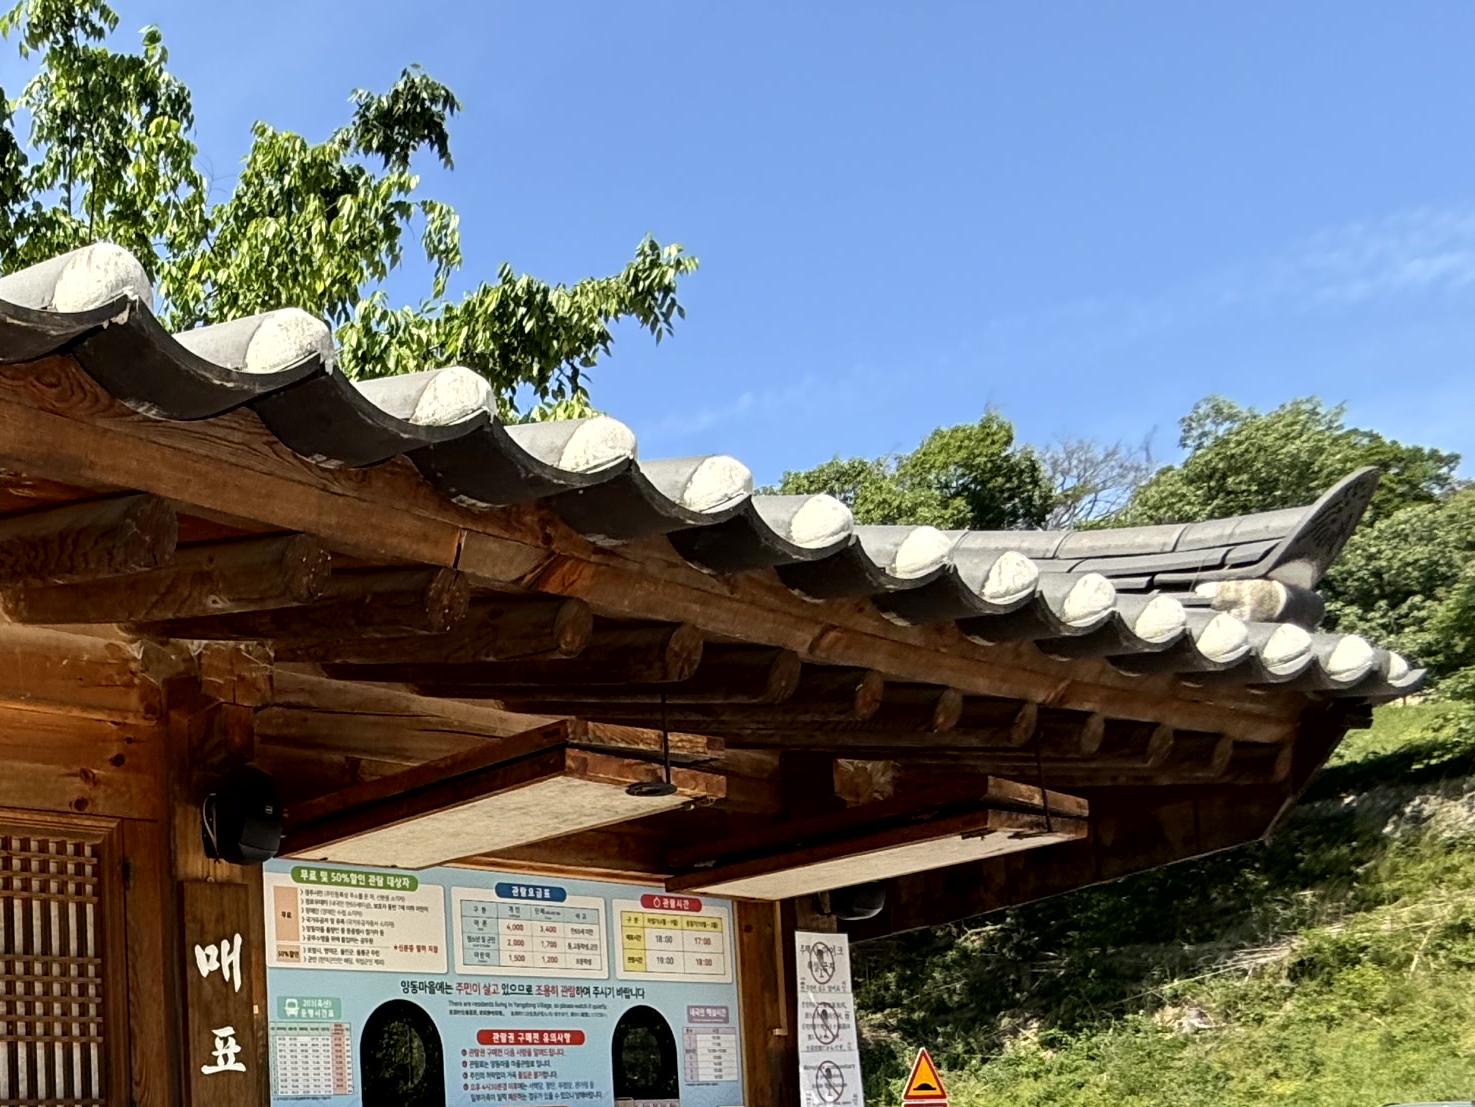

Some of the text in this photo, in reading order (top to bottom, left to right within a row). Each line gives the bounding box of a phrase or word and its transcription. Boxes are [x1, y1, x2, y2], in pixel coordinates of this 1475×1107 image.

[300, 869, 317, 881] 무료
[331, 872, 366, 885] 50%할인
[368, 876, 384, 886] 관람
[387, 877, 410, 888] 대상자
[512, 886, 550, 898] 관람요금표
[662, 899, 689, 909] 관람시간
[695, 938, 711, 946] 17:00
[657, 957, 674, 965] 19:00
[401, 980, 645, 999] 양동마을에는 주민이 살고 있으므로 조용히 관람하여 주시기 바랍니다
[493, 1033, 514, 1043] 관람권
[543, 1033, 571, 1043] 유의사항
